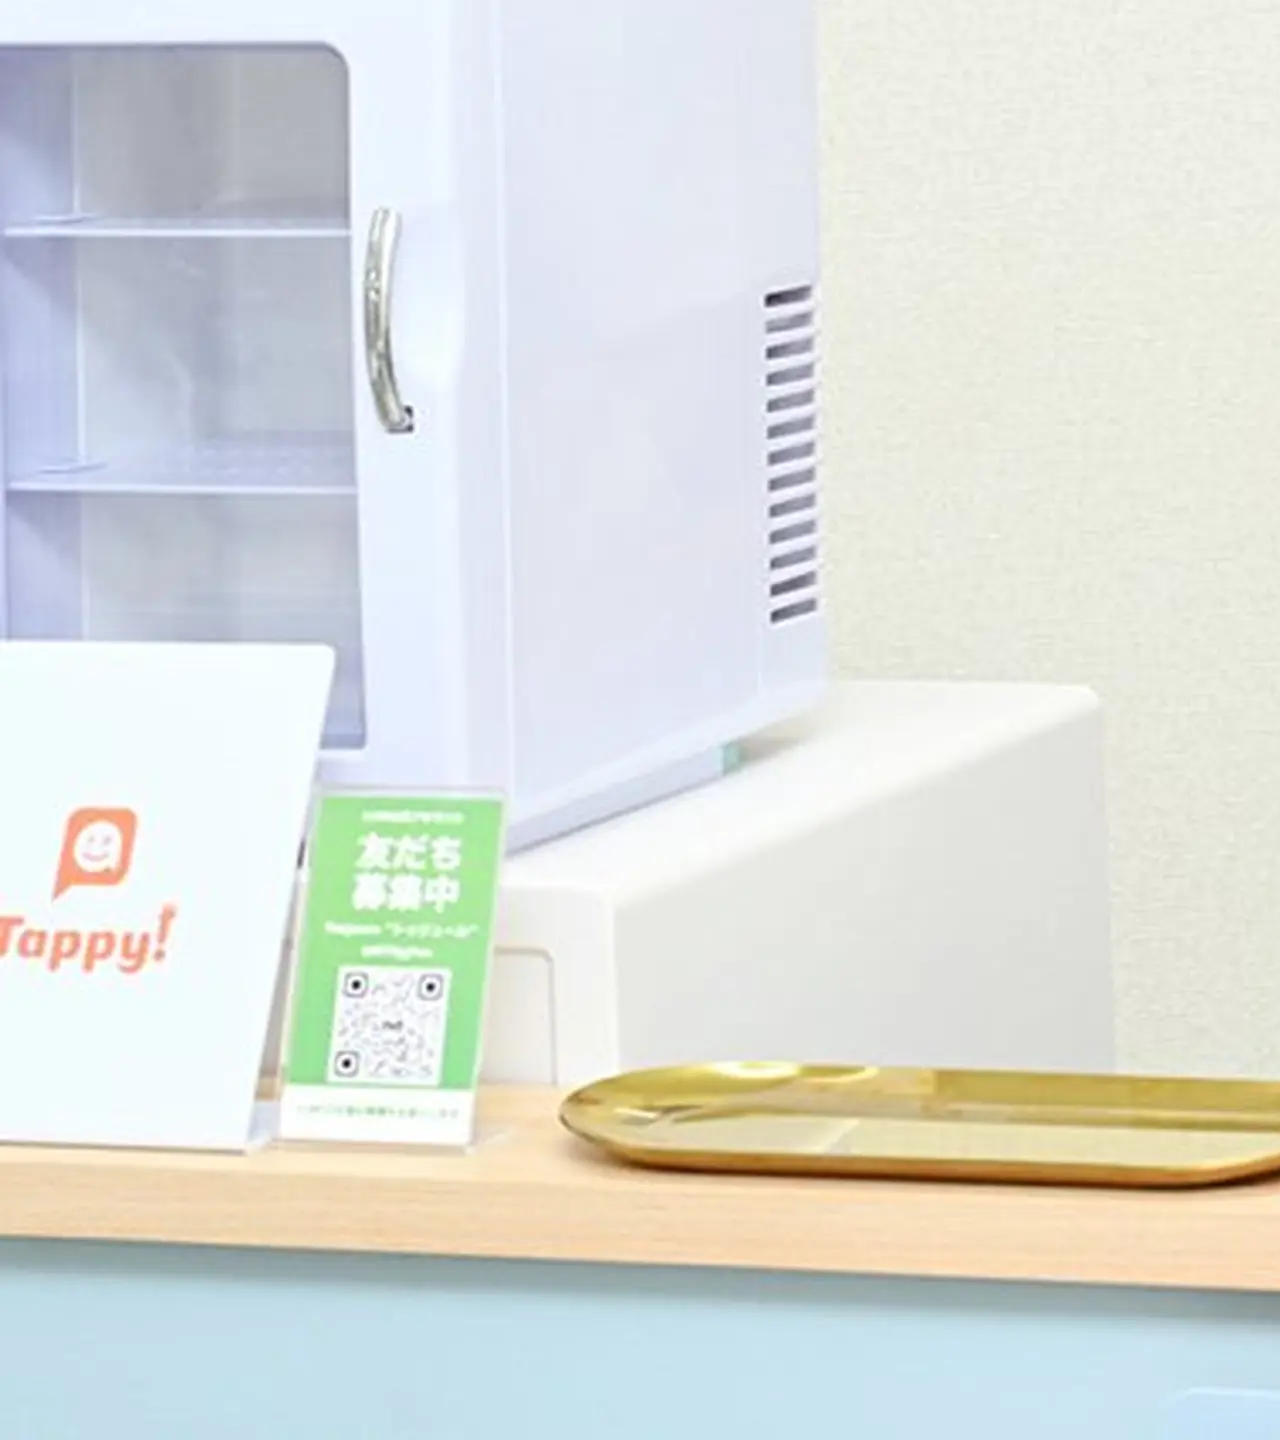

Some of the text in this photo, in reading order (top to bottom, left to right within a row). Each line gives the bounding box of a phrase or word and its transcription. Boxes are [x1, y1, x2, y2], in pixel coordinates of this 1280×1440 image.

[354, 831, 463, 872] 友だち
[0, 902, 178, 975] Tappy!
